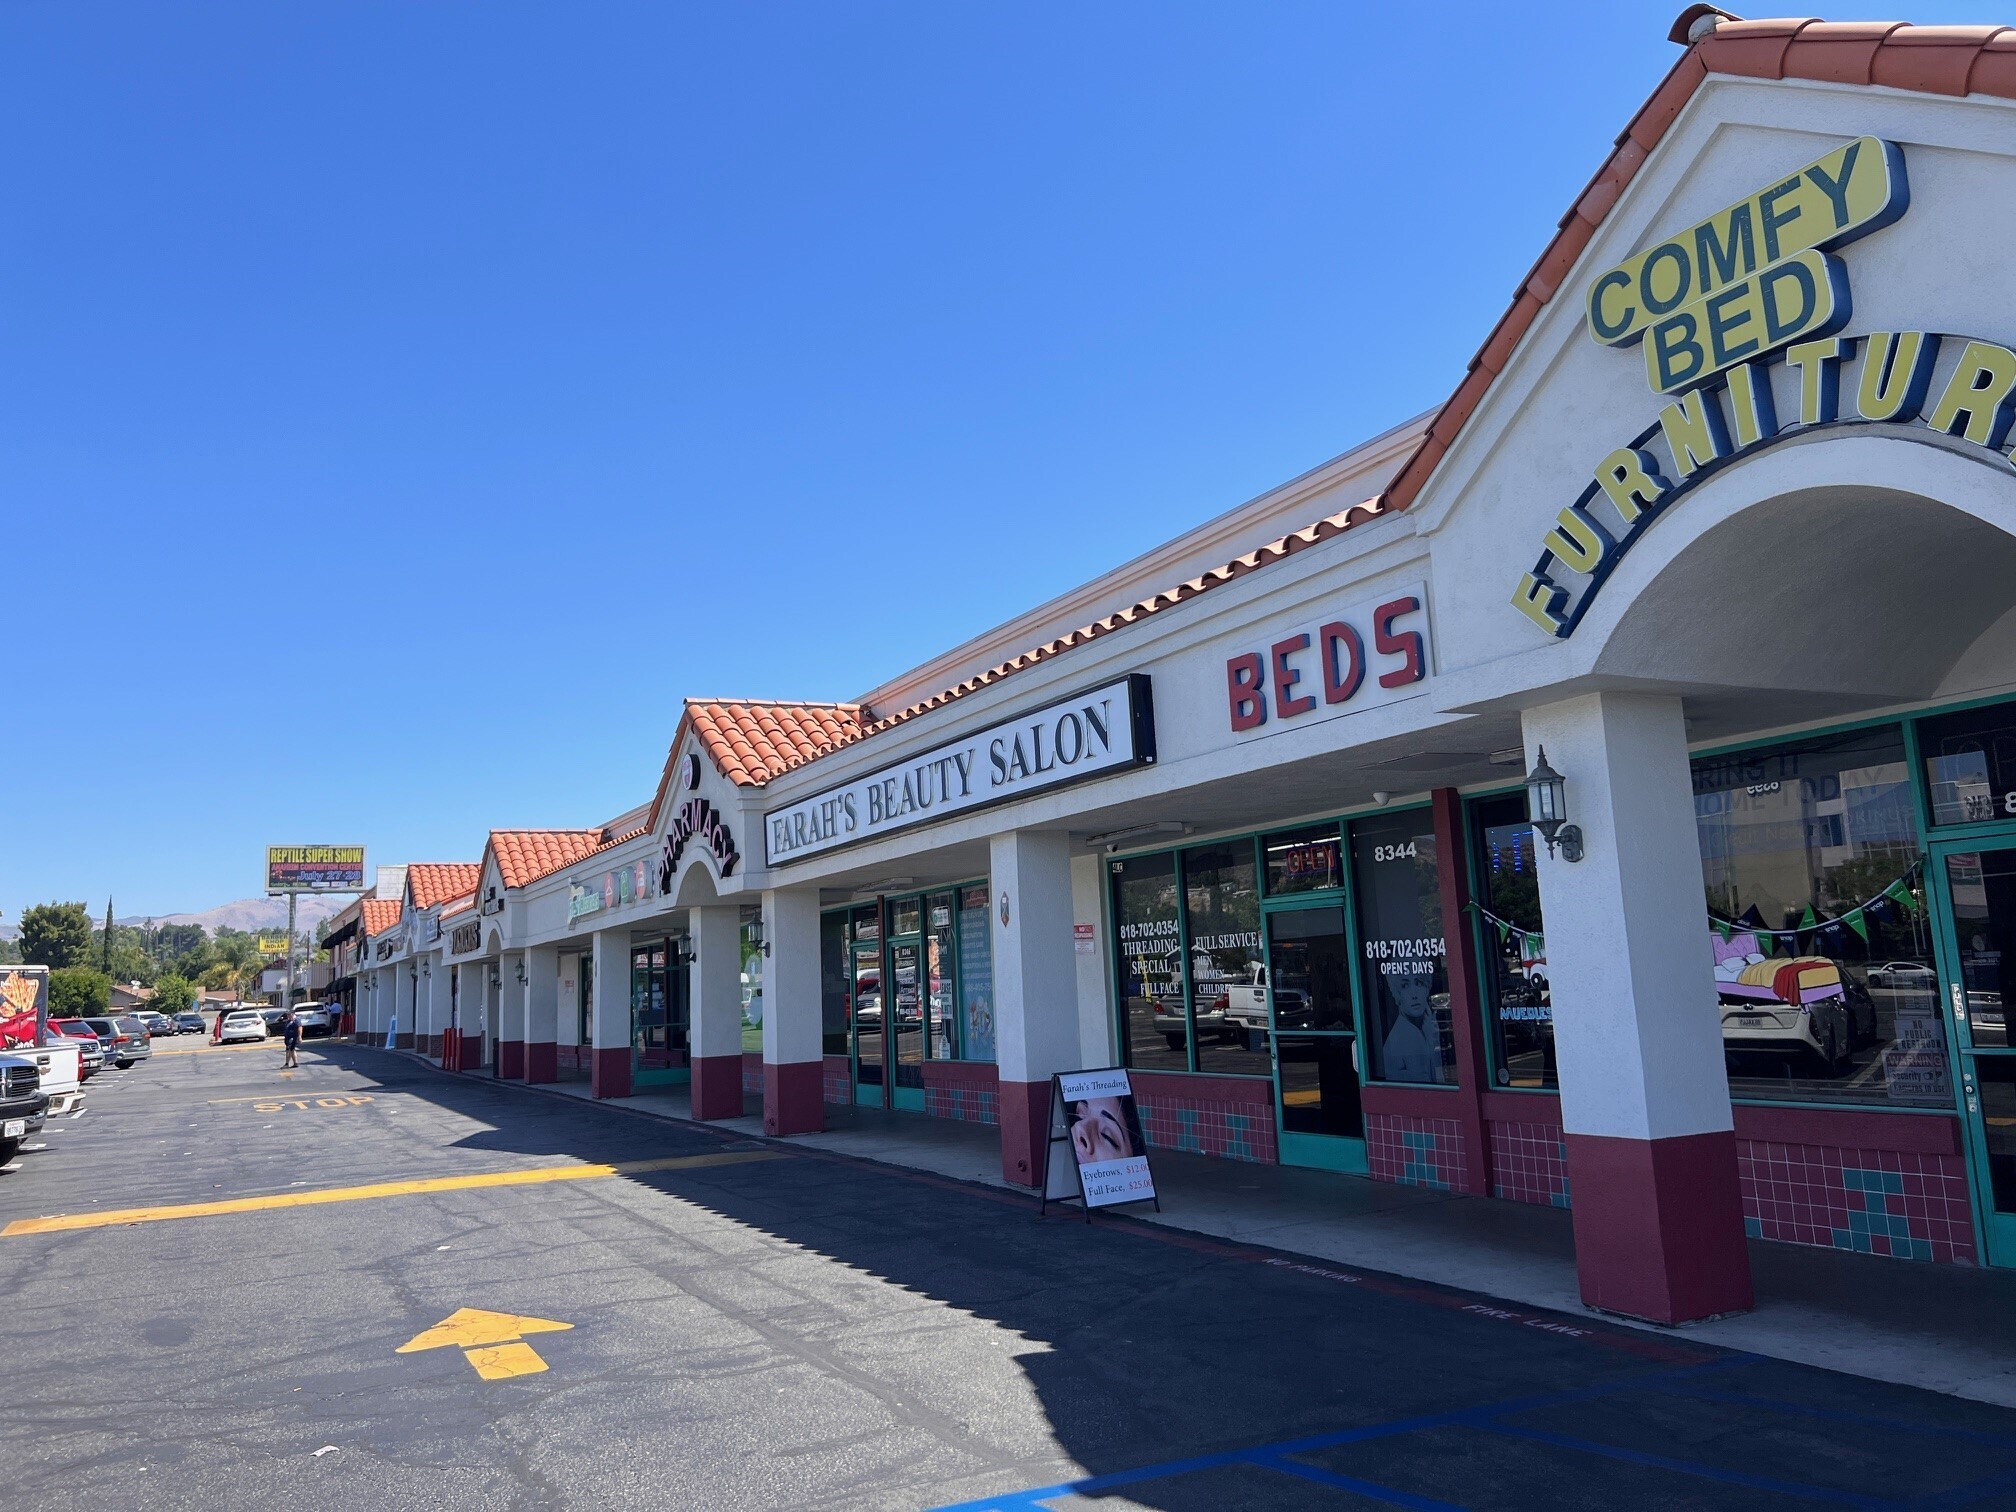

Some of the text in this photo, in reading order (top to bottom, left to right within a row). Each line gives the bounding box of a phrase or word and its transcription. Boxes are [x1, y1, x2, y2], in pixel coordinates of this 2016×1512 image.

[1590, 141, 1862, 340] COMFY
[1652, 259, 1818, 391] BED
[1510, 331, 2016, 639] FURNITUR
[1227, 595, 1425, 732] BEDS
[771, 699, 1112, 855] FARAH'S BEAUTY SALON
[271, 848, 362, 863] REPTILE SUPER SHOW
[659, 798, 737, 897] PHARMACY
[1374, 841, 1417, 862] 8344
[300, 863, 339, 871] CONVENTION
[1287, 844, 1336, 874] OPEN
[299, 871, 324, 881] July
[1120, 918, 1179, 939] 818-702-0354
[1123, 938, 1178, 956] THREADING
[1195, 931, 1258, 951] FULL SERVICE
[1366, 938, 1446, 959] 818-702-0354
[1131, 958, 1171, 975] SPECIAL
[1197, 955, 1213, 966] MEN
[1381, 961, 1403, 975] OPEN
[1412, 960, 1434, 975] DAYS
[1197, 969, 1225, 980] WOMEN
[1140, 981, 1180, 997] FULL FACE
[1912, 1020, 1923, 1030] NO
[1904, 1030, 1932, 1040] PUBLIC
[1888, 1054, 1943, 1067] WARNING
[1062, 1080, 1127, 1094] Farah's Threading
[253, 1096, 375, 1112] STOP
[1083, 1168, 1123, 1181] Eyebrows,
[1088, 1186, 1104, 1197] Full
[1105, 1185, 1126, 1195] Face,
[1262, 1258, 1362, 1283] NO PARKING
[1462, 1304, 1593, 1337] FIRE LANE
